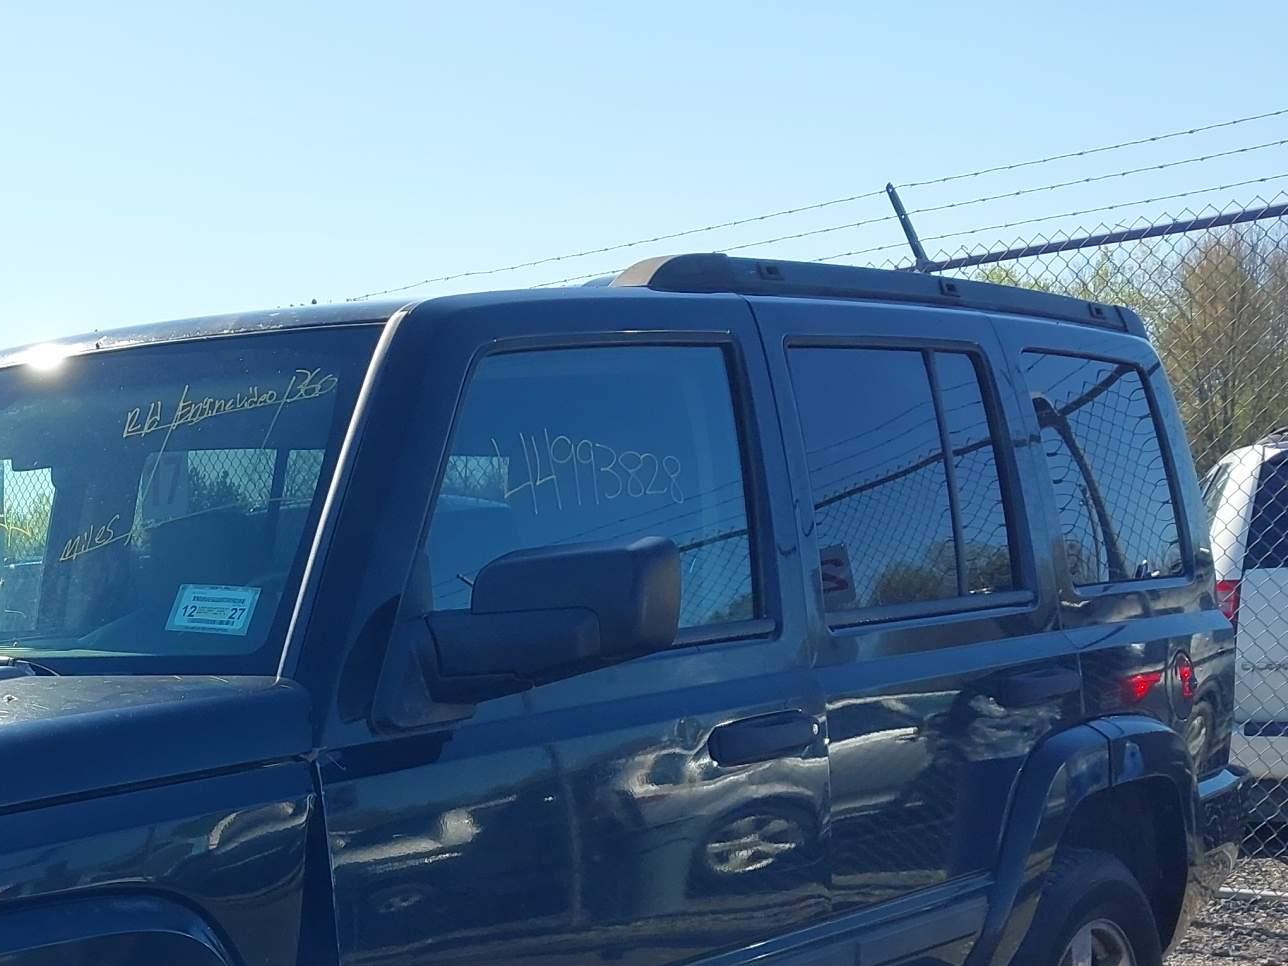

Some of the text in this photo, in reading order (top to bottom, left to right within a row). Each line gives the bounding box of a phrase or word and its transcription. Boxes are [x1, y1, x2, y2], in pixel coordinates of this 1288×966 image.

[491, 428, 684, 515] 44993828
[182, 604, 198, 618] 12
[228, 607, 247, 621] 27
